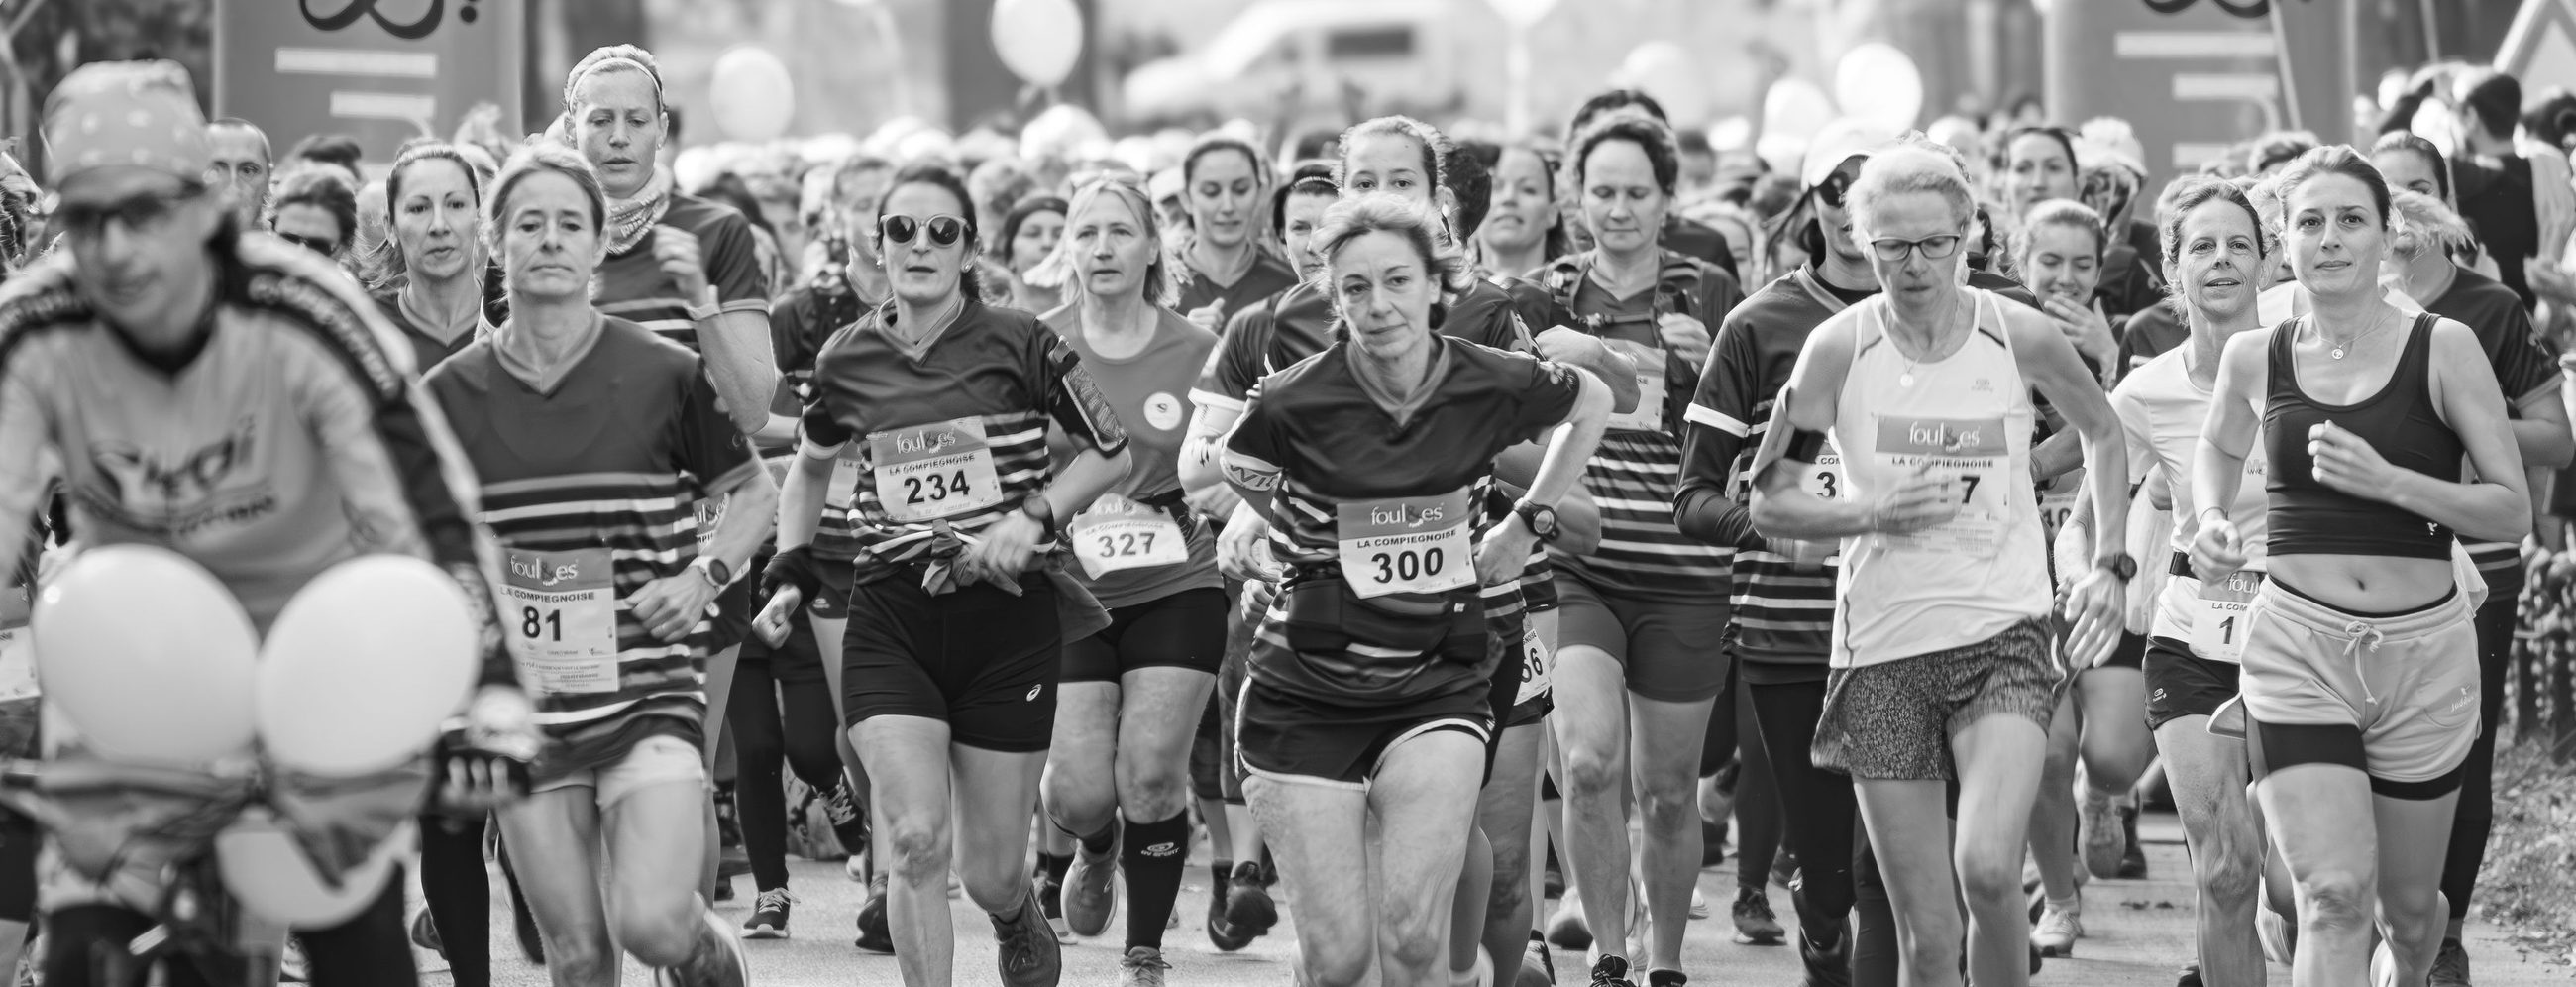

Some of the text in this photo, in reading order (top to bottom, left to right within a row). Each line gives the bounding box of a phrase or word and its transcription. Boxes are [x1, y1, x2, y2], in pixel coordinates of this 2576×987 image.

[1891, 456, 1906, 466] LA
[903, 469, 970, 506] 234
[1816, 471, 1837, 500] 3
[1097, 532, 1156, 558] 327
[1374, 529, 1457, 547] COMPIEGNOISE
[1370, 547, 1444, 584] 300
[514, 590, 595, 603] COMPIEGNOISE
[522, 605, 562, 642] 81
[2219, 616, 2235, 645] 1
